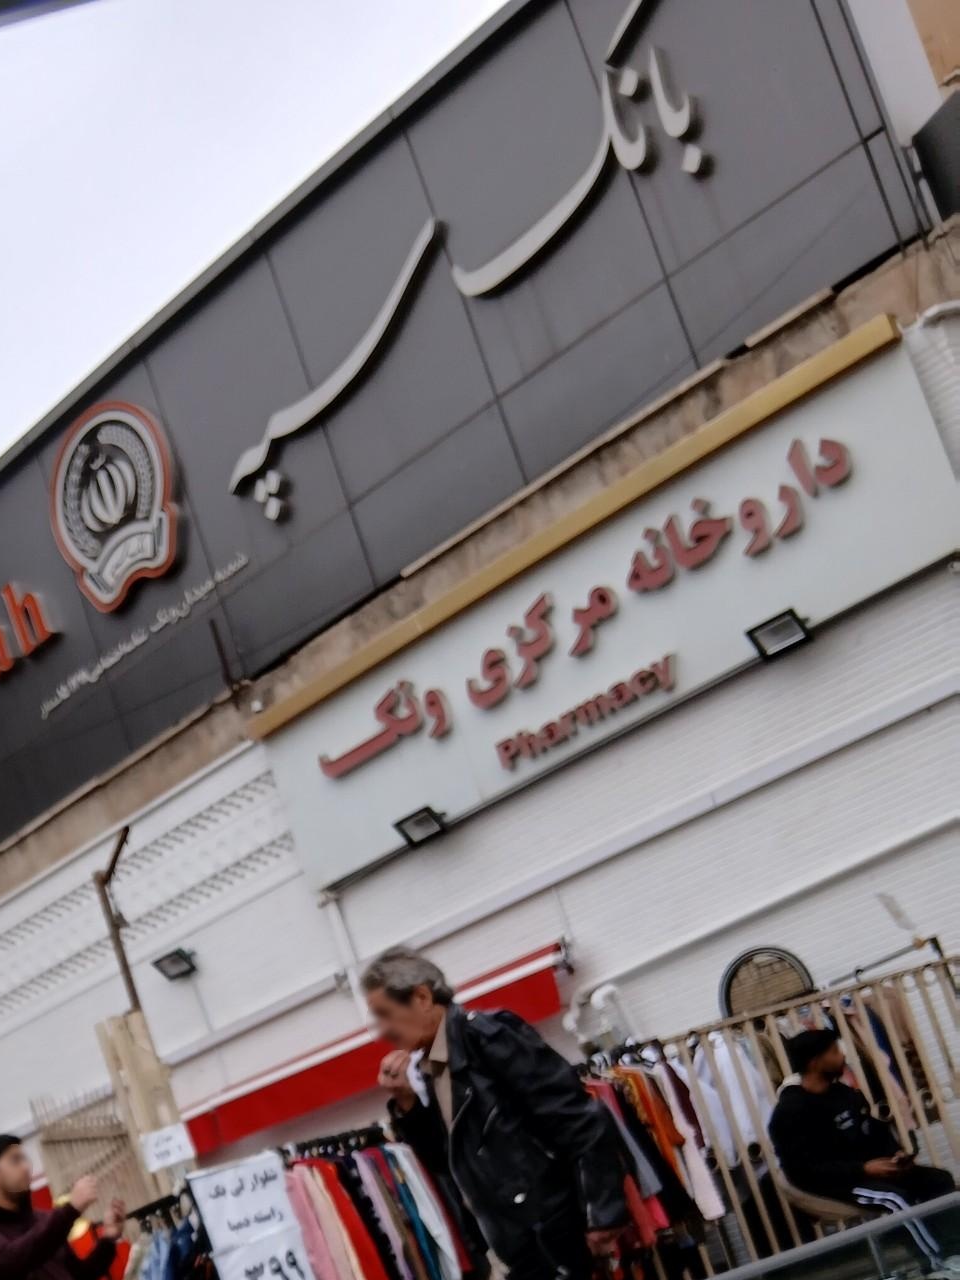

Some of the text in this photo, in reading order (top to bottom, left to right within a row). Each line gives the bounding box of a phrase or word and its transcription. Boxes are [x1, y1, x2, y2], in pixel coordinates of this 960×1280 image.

[228, 0, 703, 522] بانک سپه
[319, 437, 851, 779] داروخانه مرکزی ونک
[496, 653, 677, 771] Pharmacy
